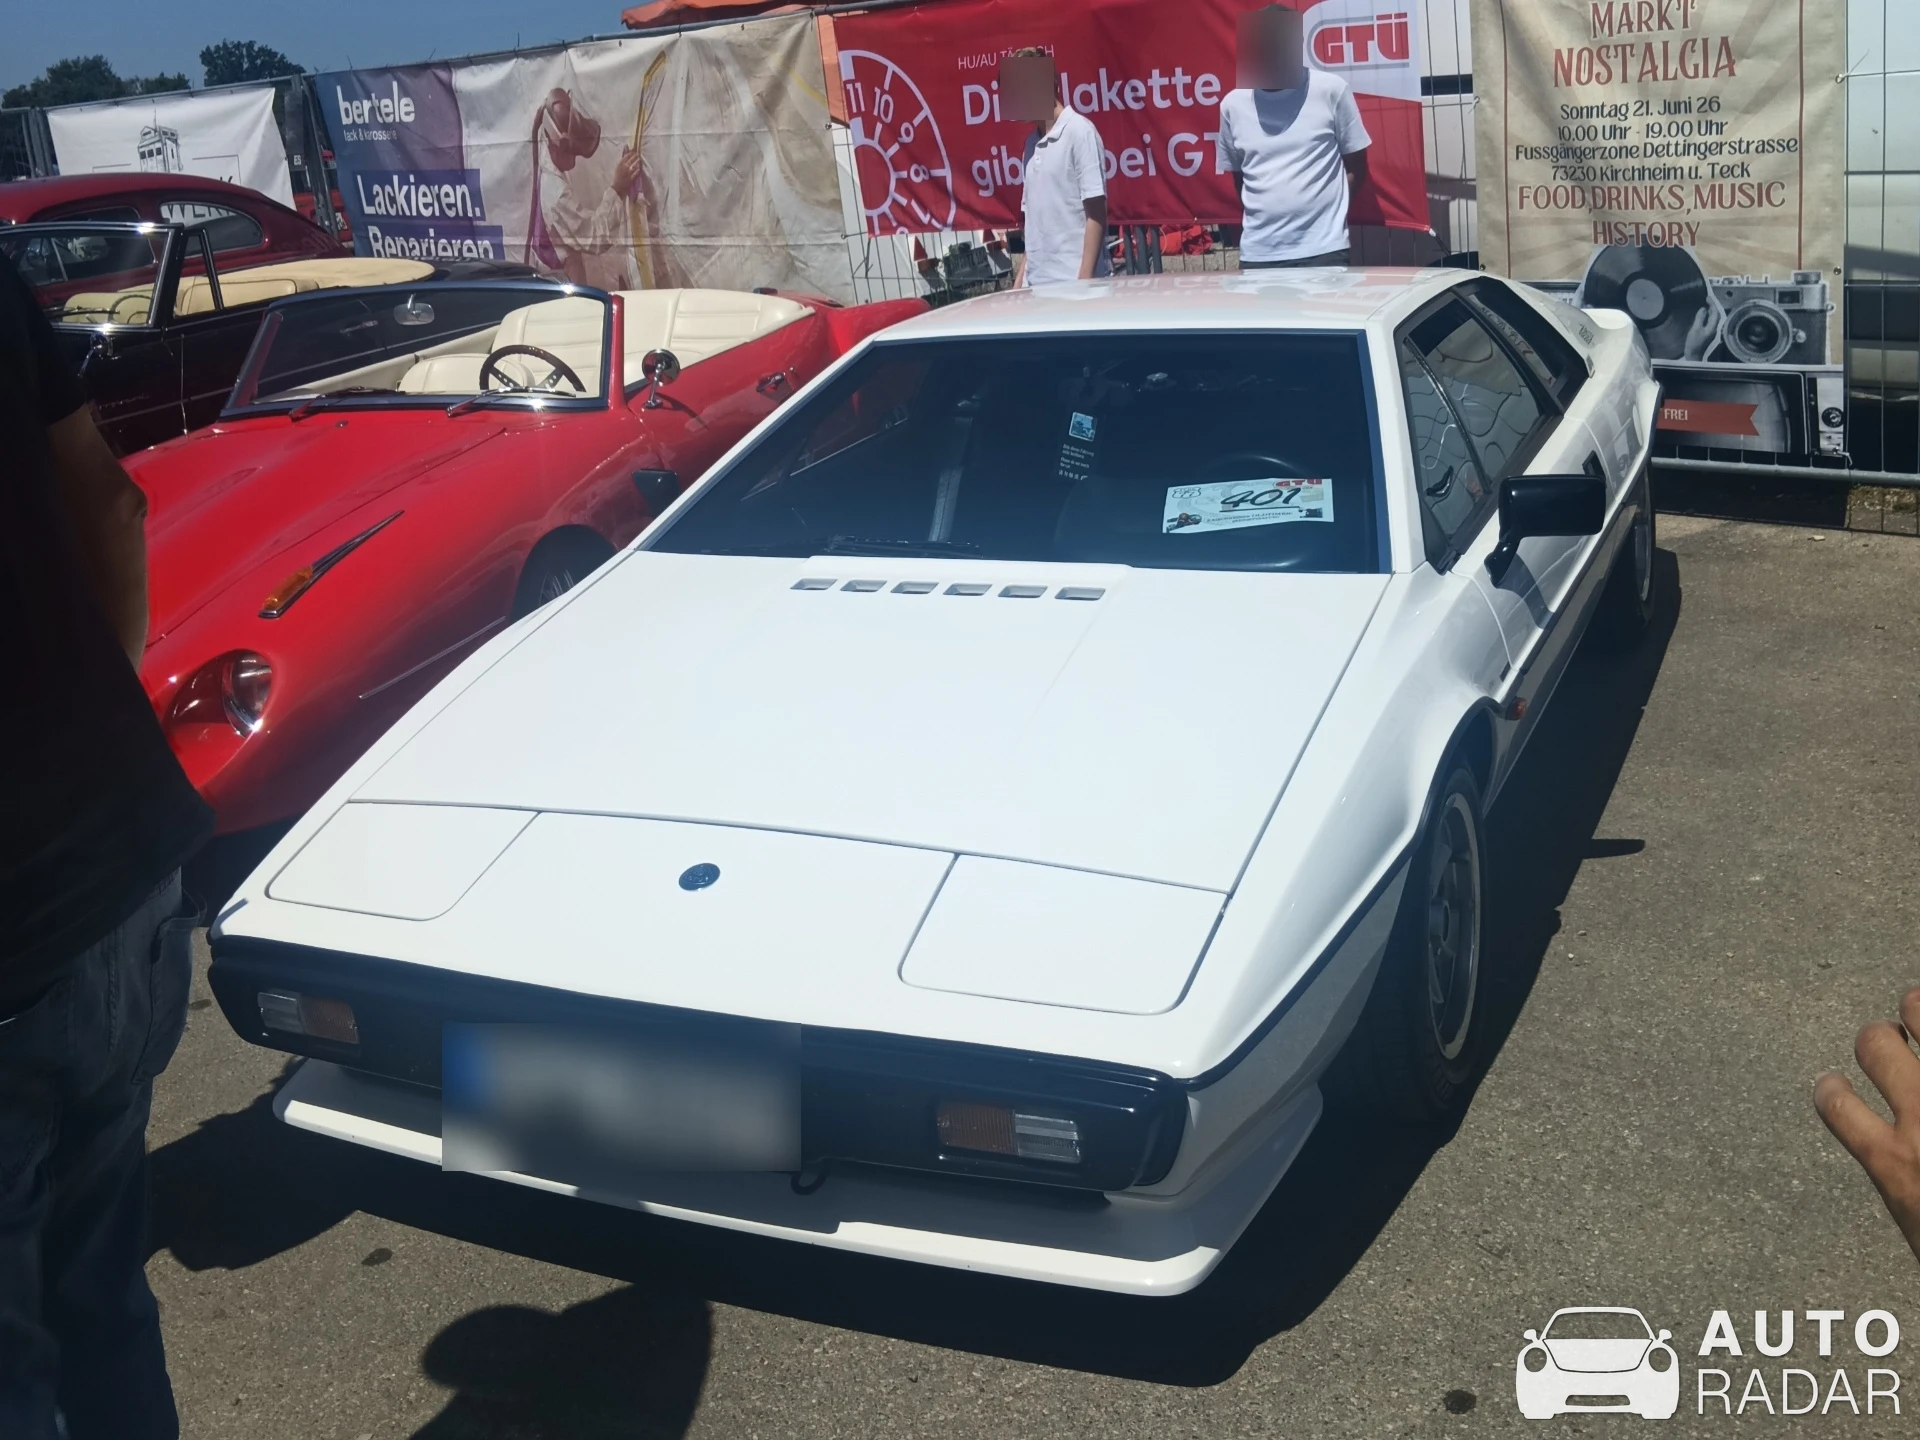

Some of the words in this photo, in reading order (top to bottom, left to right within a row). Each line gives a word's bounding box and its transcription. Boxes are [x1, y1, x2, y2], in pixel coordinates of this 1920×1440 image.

[1592, 0, 1695, 38] MARKT
[1313, 12, 1409, 64] GTÜ
[958, 53, 997, 70] HU/AU
[1553, 36, 1736, 88] NOSTALGIA
[336, 81, 415, 125] bertele
[846, 82, 866, 113] 11
[874, 86, 894, 124] 10
[962, 80, 1010, 126] Di
[1060, 67, 1222, 114] lakette
[1560, 100, 1629, 121] Sonntag
[1632, 99, 1653, 117] 21.
[1657, 96, 1692, 116] Juni
[1696, 96, 1721, 114] 26
[343, 129, 358, 142] lack
[358, 128, 364, 141] &
[1558, 125, 1598, 142] 10.00
[1602, 124, 1632, 140] Uhr
[1645, 120, 1694, 139] 19.00
[1697, 119, 1729, 137] Uhr
[1515, 143, 1640, 163] Fussgängerzone
[1643, 137, 1799, 160] Dettingerstrasse
[1551, 165, 1597, 182] 73230
[1600, 164, 1685, 181] Kirchheim
[1688, 165, 1702, 180] u.
[1707, 162, 1751, 179] Teck
[356, 174, 481, 218] Lackieren.
[1592, 220, 1701, 247] HISTORY
[1664, 408, 1689, 421] FREI
[1220, 488, 1302, 508] 401
